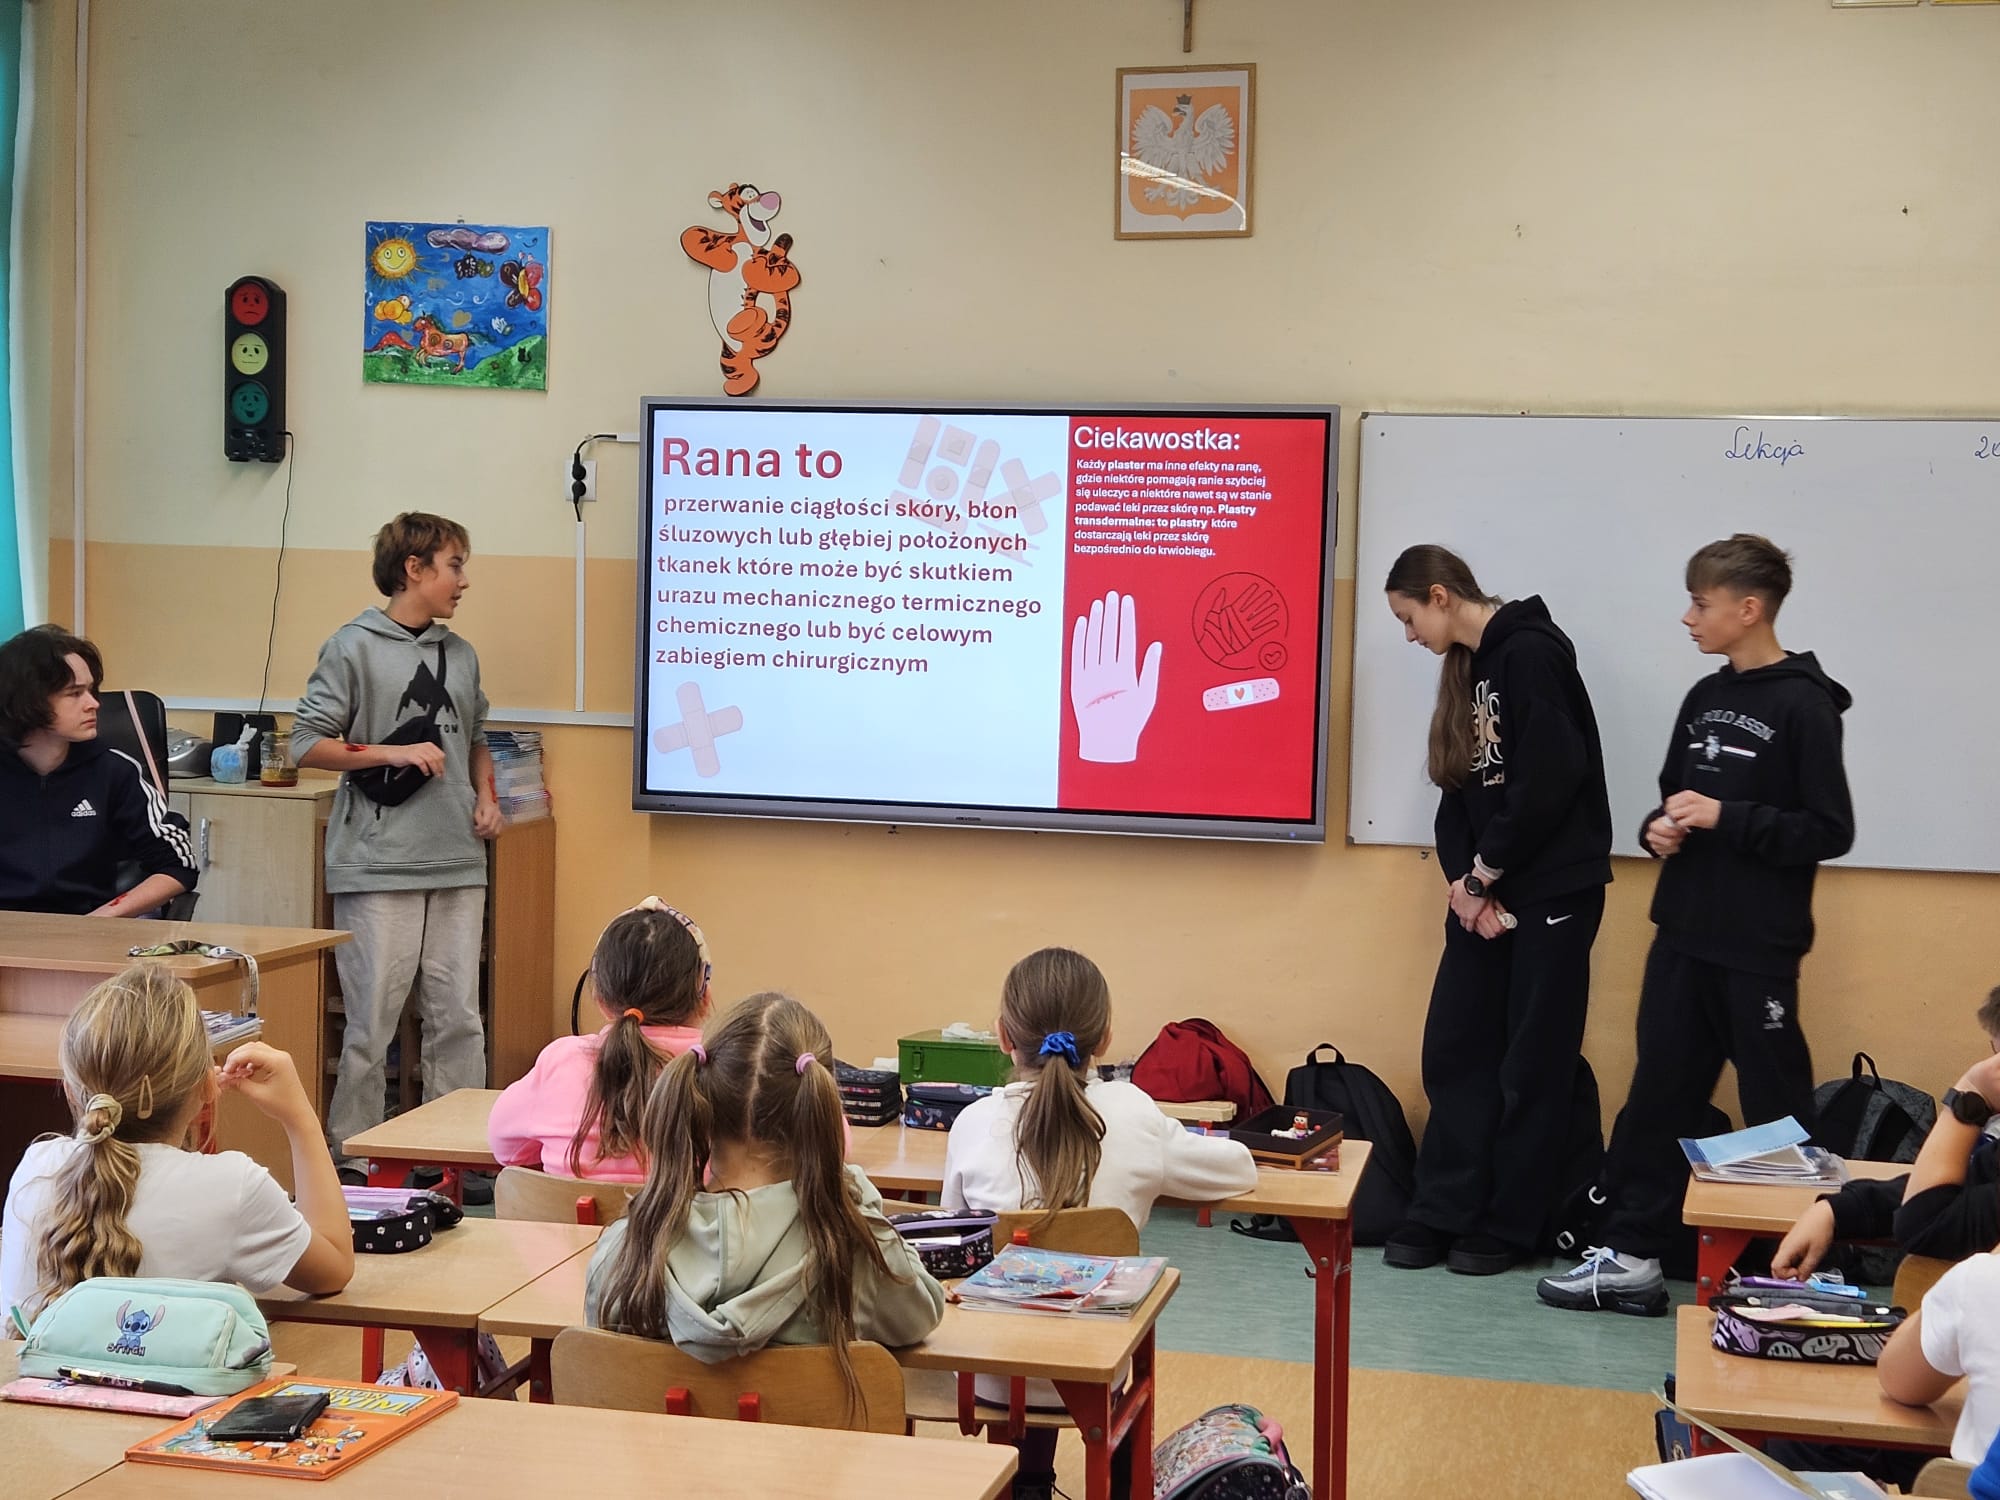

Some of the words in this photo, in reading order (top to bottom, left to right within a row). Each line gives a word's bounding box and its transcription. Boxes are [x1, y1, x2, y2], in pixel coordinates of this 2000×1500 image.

[1075, 426, 1240, 450] Ciekawostka:
[662, 438, 781, 478] Rana
[794, 444, 843, 479] to
[1077, 460, 1106, 471] Każdy
[1108, 460, 1145, 471] plaster
[1165, 461, 1187, 470] inne
[1189, 461, 1219, 472] efekty
[1236, 464, 1261, 473] ranę,
[1076, 474, 1102, 484] gdzie
[1104, 474, 1144, 483] niektóre
[1147, 475, 1196, 486] pomagają
[1198, 476, 1223, 485] ranie
[1225, 476, 1265, 487] szybciej
[1076, 488, 1090, 499] się
[1140, 489, 1181, 498] niektóre
[1183, 491, 1214, 499] nawet
[1215, 492, 1227, 501] są
[1240, 491, 1271, 500] stanie
[664, 496, 784, 516] przerwanie
[790, 497, 889, 520] ciągłości
[895, 499, 961, 523] skóry,
[968, 501, 1017, 519] błon
[1076, 502, 1121, 512] podawać
[1123, 503, 1140, 512] leki
[1142, 505, 1168, 514] przez
[1171, 504, 1198, 515] skórę
[1200, 506, 1216, 515] np.
[1218, 504, 1256, 516] Plastry
[1075, 516, 1155, 526] transdermalne:
[1157, 518, 1168, 527] to
[1170, 518, 1208, 529] plastry
[1212, 519, 1237, 528] które
[658, 525, 772, 548] śluzowych
[779, 528, 813, 546] lub
[818, 529, 892, 552] głębiej
[899, 532, 1027, 555] położonych
[1075, 530, 1132, 542] dostarczają
[1134, 531, 1151, 540] leki
[1153, 533, 1179, 542] przez
[1182, 532, 1209, 543] skórę
[1074, 544, 1141, 555] bezpośrednio
[1143, 545, 1156, 554] do
[1158, 546, 1215, 557] krwiobiegu.
[657, 556, 731, 574] tkanek
[737, 558, 793, 576] które
[800, 560, 858, 578] może
[864, 561, 902, 583] być
[909, 563, 1012, 582] skutkiem
[656, 587, 717, 606] urazu
[723, 589, 896, 614] mechanicznego
[901, 594, 1041, 618] termicznego
[657, 616, 801, 642] chemicznego
[807, 621, 842, 639] lub
[848, 622, 885, 644] być
[892, 625, 992, 647] celowym
[655, 647, 766, 670] zabiegiem
[772, 651, 928, 676] chirurgicznym
